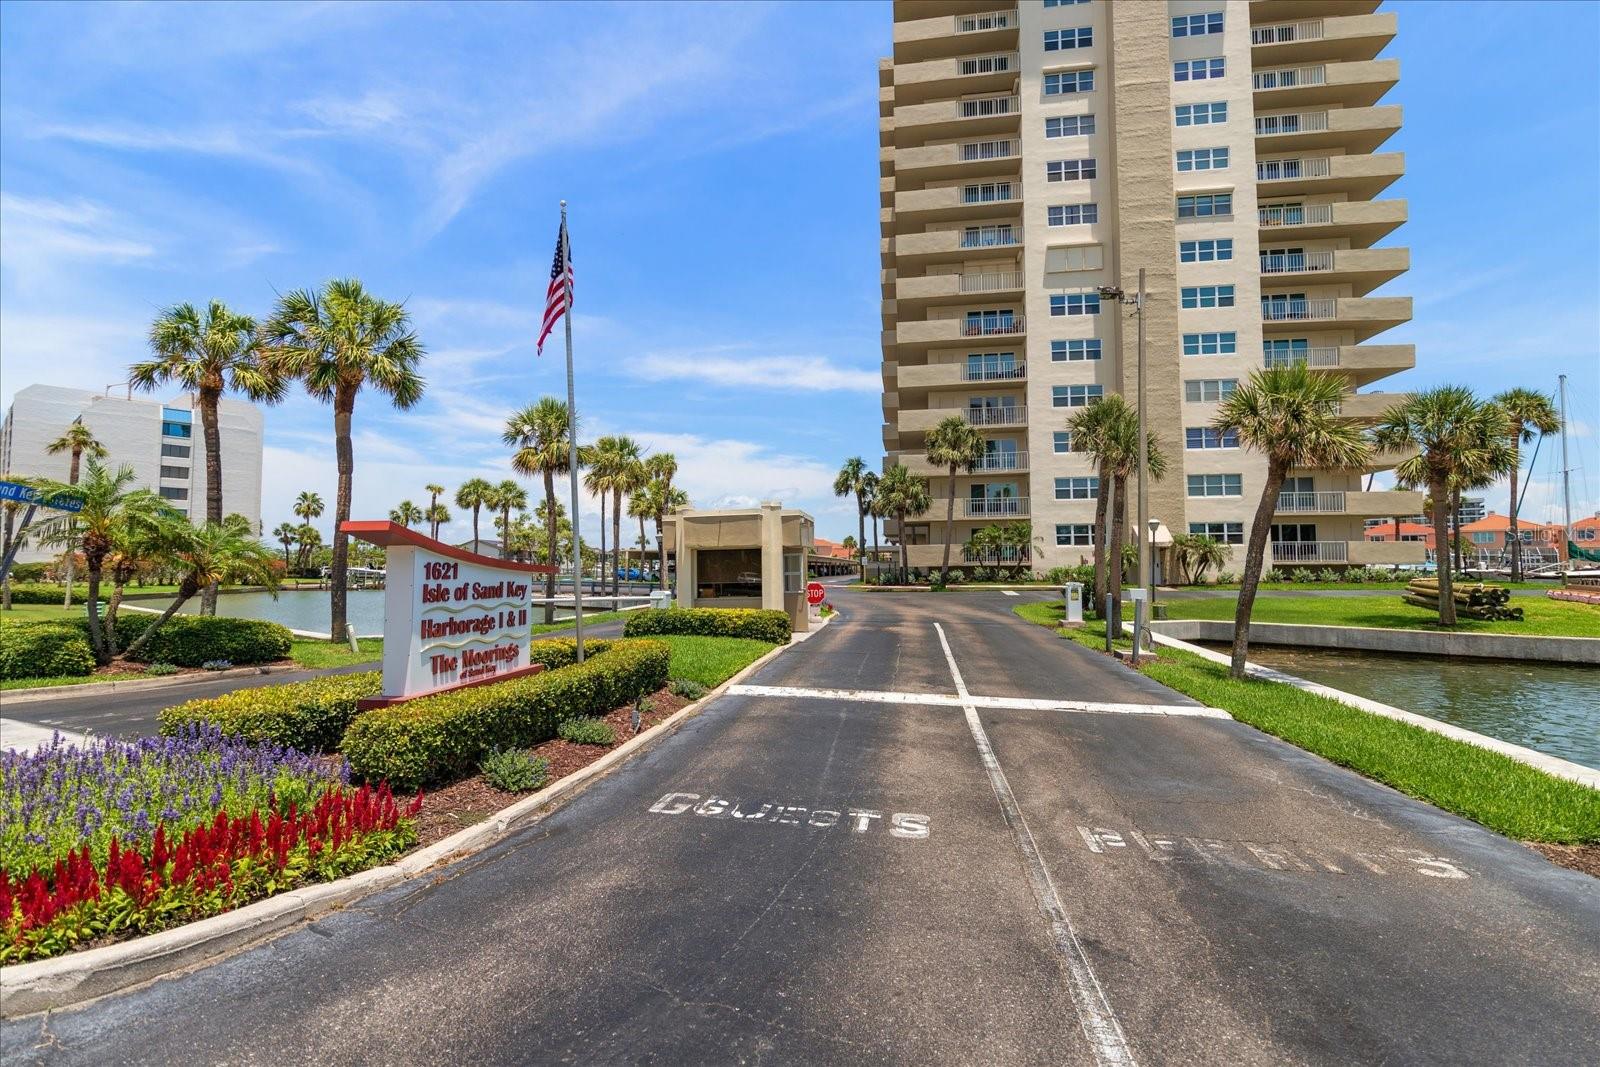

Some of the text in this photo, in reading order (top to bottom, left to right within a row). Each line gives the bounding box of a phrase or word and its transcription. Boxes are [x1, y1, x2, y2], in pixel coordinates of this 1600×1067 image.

[0, 485, 17, 496] nd
[424, 562, 459, 580] 1621
[422, 581, 528, 603] Isle of Sand Key
[807, 589, 824, 598] STOP
[420, 609, 527, 640] Harborage I & II
[430, 643, 520, 675] The Moorings
[460, 663, 496, 680] of Sand Key
